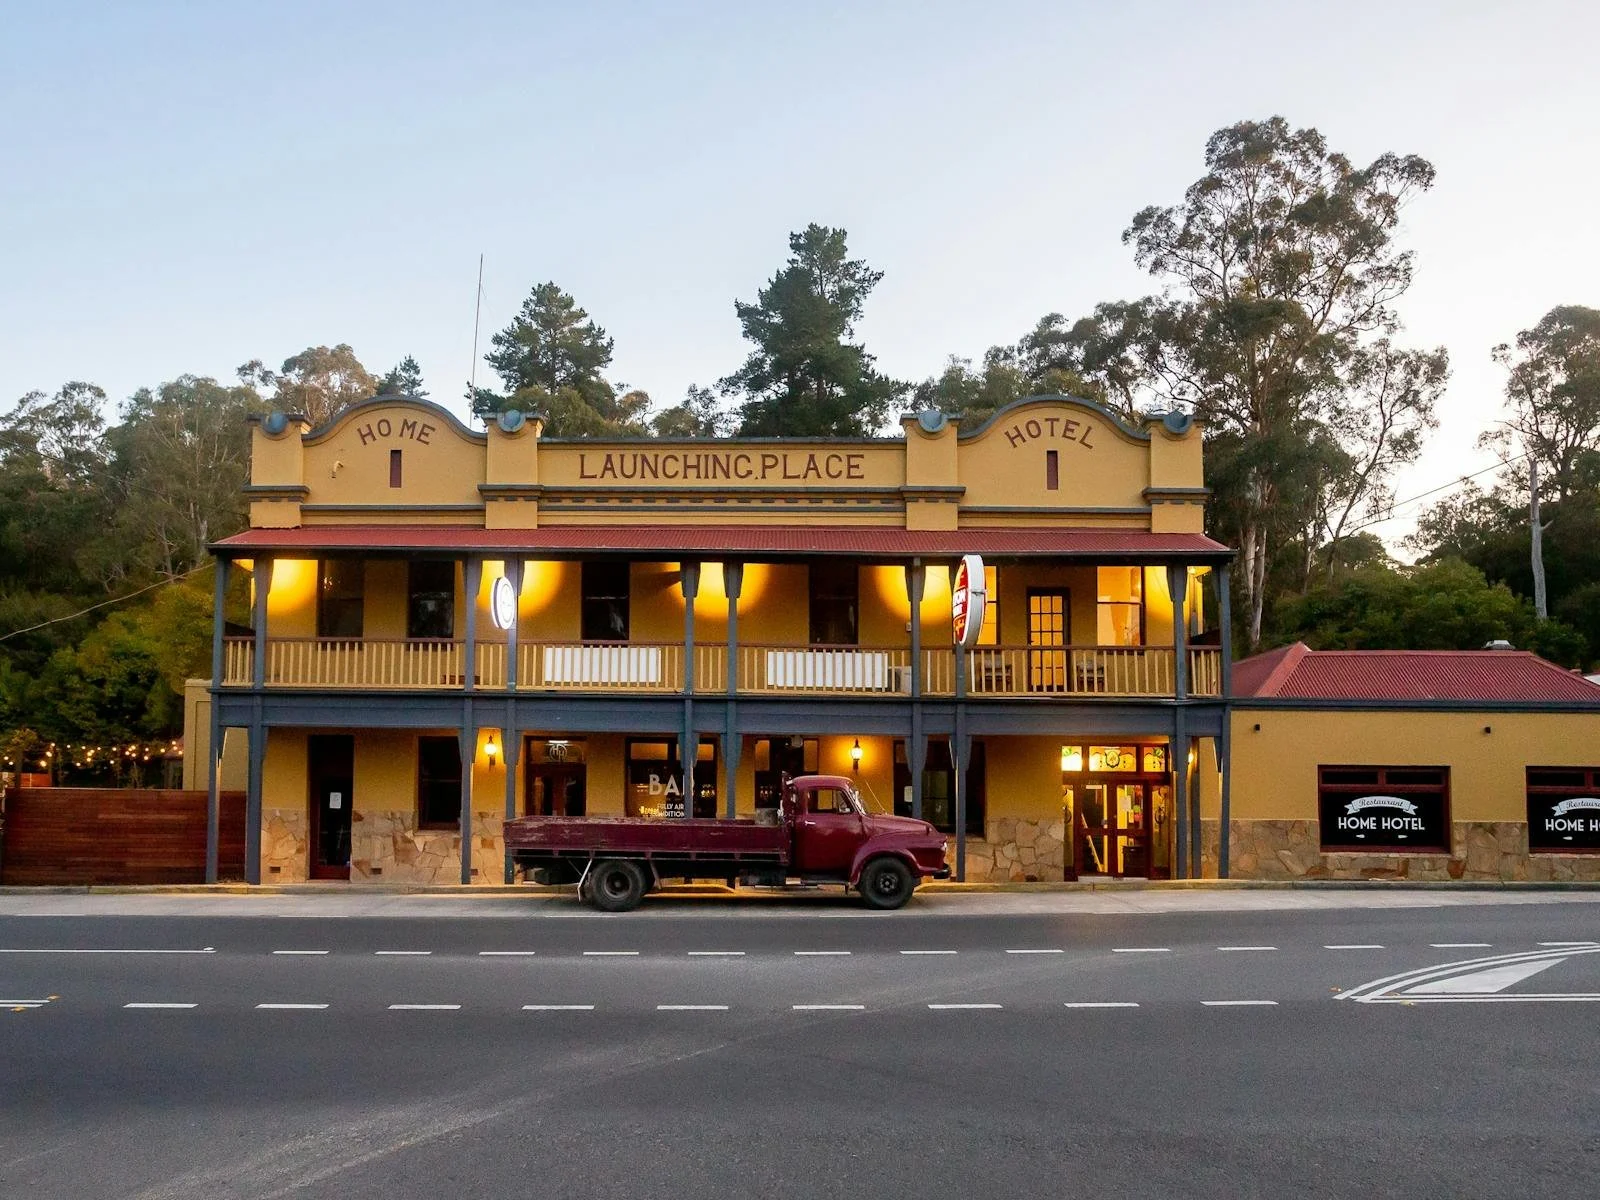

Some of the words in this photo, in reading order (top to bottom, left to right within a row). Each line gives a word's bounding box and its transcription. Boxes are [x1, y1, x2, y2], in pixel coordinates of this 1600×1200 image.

[357, 418, 436, 446] HOME
[1004, 417, 1094, 450] HOTEL
[648, 773, 687, 796] BA
[1359, 798, 1404, 807] Restaurant
[1337, 816, 1377, 830] HOME
[1381, 816, 1426, 831] HOTEL
[1545, 818, 1585, 832] HOME
[1589, 818, 1600, 832] H
